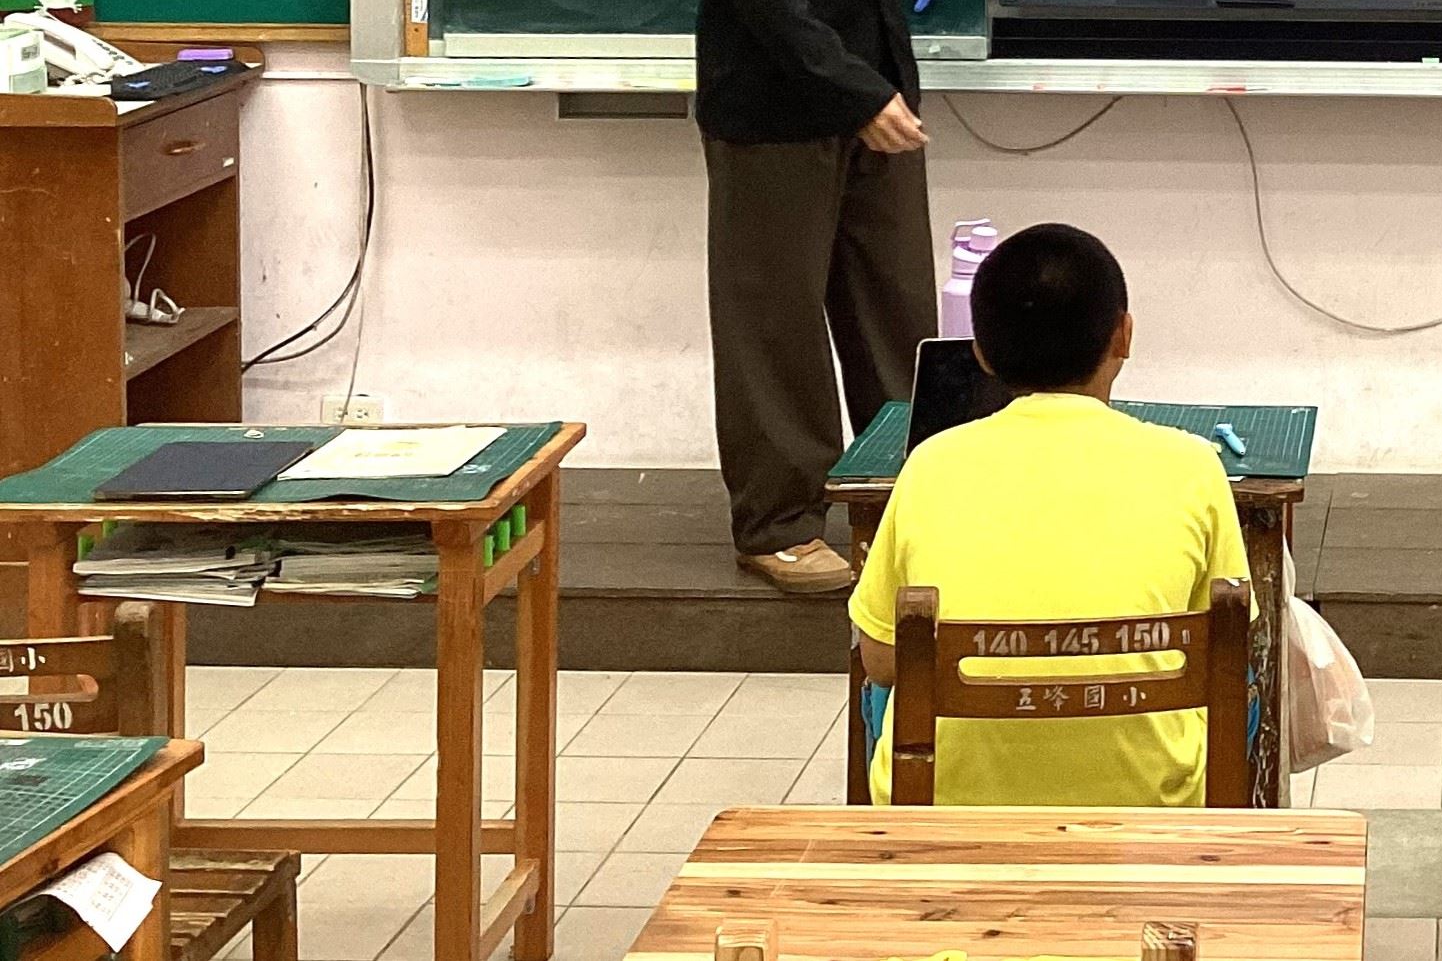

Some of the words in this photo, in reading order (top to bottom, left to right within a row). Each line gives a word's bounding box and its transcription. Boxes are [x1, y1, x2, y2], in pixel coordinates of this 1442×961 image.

[972, 629, 1028, 656] 140
[1044, 627, 1100, 654] 145
[1115, 621, 1171, 653] 150
[14, 701, 73, 731] 150
